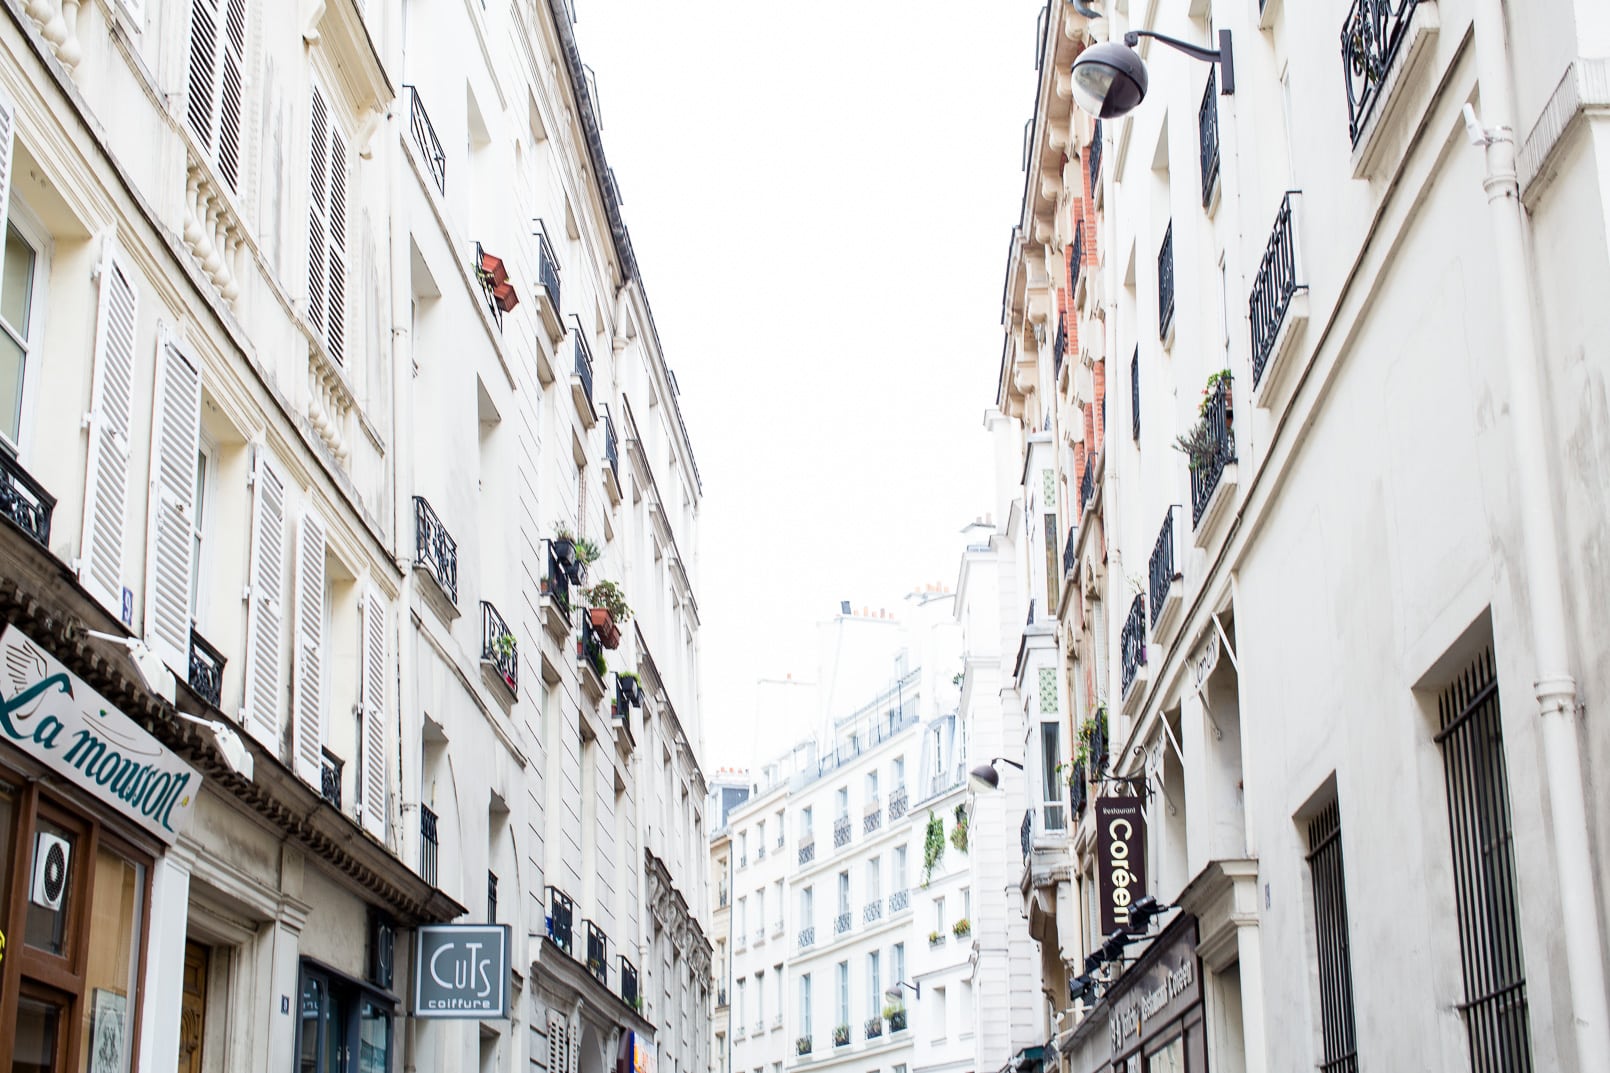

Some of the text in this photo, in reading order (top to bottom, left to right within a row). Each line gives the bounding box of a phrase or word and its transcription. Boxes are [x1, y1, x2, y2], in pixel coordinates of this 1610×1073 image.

[0, 673, 190, 833] La mousson
[1102, 807, 1136, 815] Restaurant
[1109, 818, 1138, 924] Coréen
[428, 998, 491, 1009] coiffure
